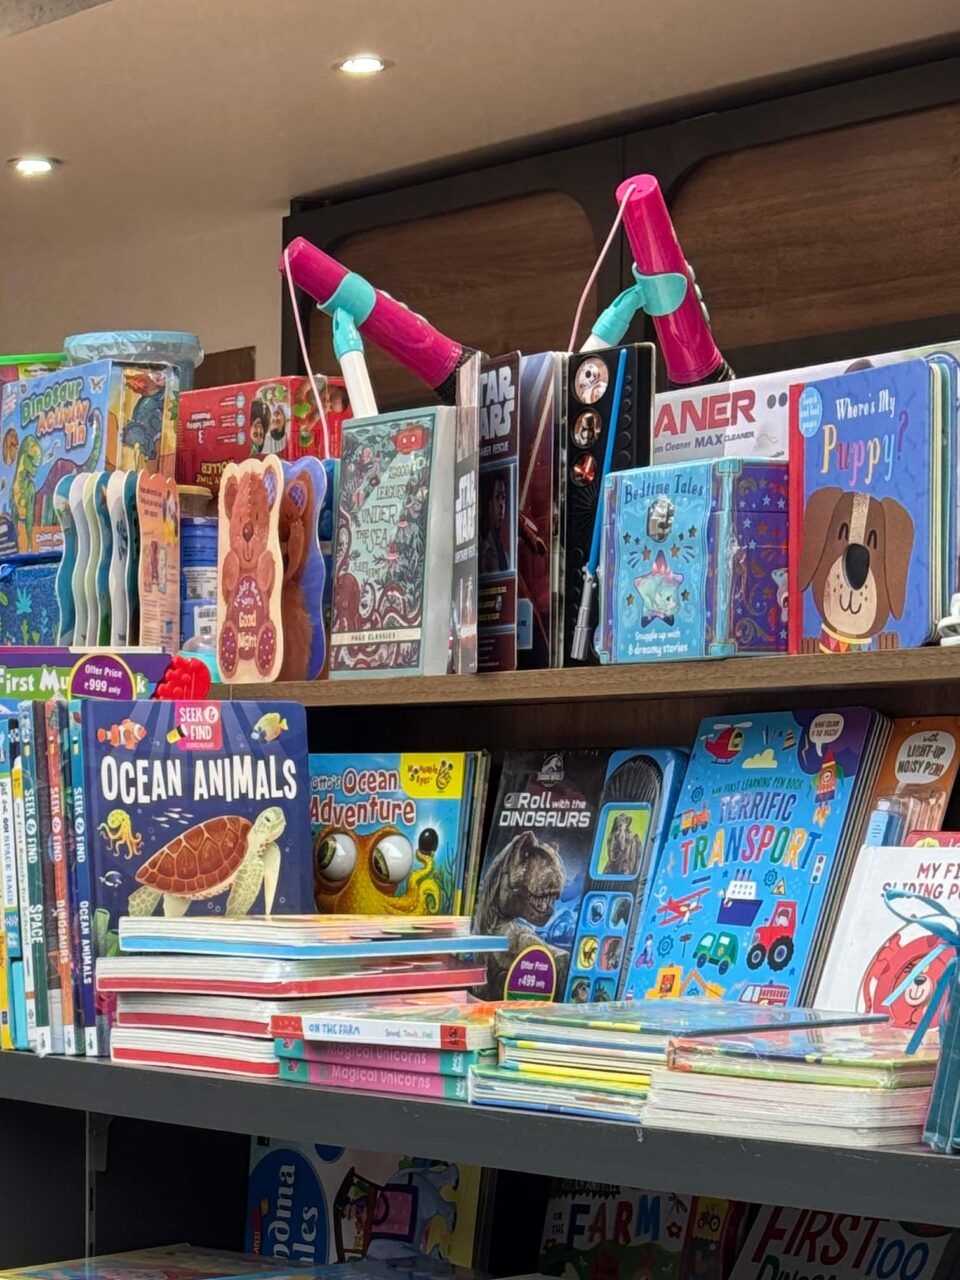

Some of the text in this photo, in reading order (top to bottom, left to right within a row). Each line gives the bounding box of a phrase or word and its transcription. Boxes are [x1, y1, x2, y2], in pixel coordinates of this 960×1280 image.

[21, 379, 84, 425] Dinosaur
[836, 389, 896, 420] Where's My
[37, 400, 89, 434] Activity
[65, 421, 87, 449] Tin
[695, 433, 724, 449] MAX
[624, 475, 704, 504] Bedtime Tales
[84, 664, 123, 679] Offer Price
[108, 686, 122, 697] only
[179, 706, 203, 724] SEEK
[191, 725, 213, 741] FIND
[907, 744, 946, 759] LIGHT-UP
[101, 755, 297, 804] OCEAN ANIMALS
[342, 768, 398, 794] Ocean
[49, 785, 61, 817] SEEK
[310, 796, 416, 829] Adventure
[519, 791, 587, 810] Roll with the
[719, 791, 797, 824] TERRIFIC
[499, 811, 591, 828] DINOSAURS
[52, 835, 63, 863] FIND
[681, 823, 823, 878] TRANSPORT
[24, 788, 44, 945] SEEK FIND SPACE
[917, 863, 942, 879] MY
[74, 786, 93, 985] SEEK FIND OCEAN ANIMALS
[309, 1023, 361, 1037] ON THE FARM
[331, 1064, 431, 1090] Magical Unicorns
[569, 1194, 661, 1249] FARM
[751, 1205, 889, 1269] FIRST
